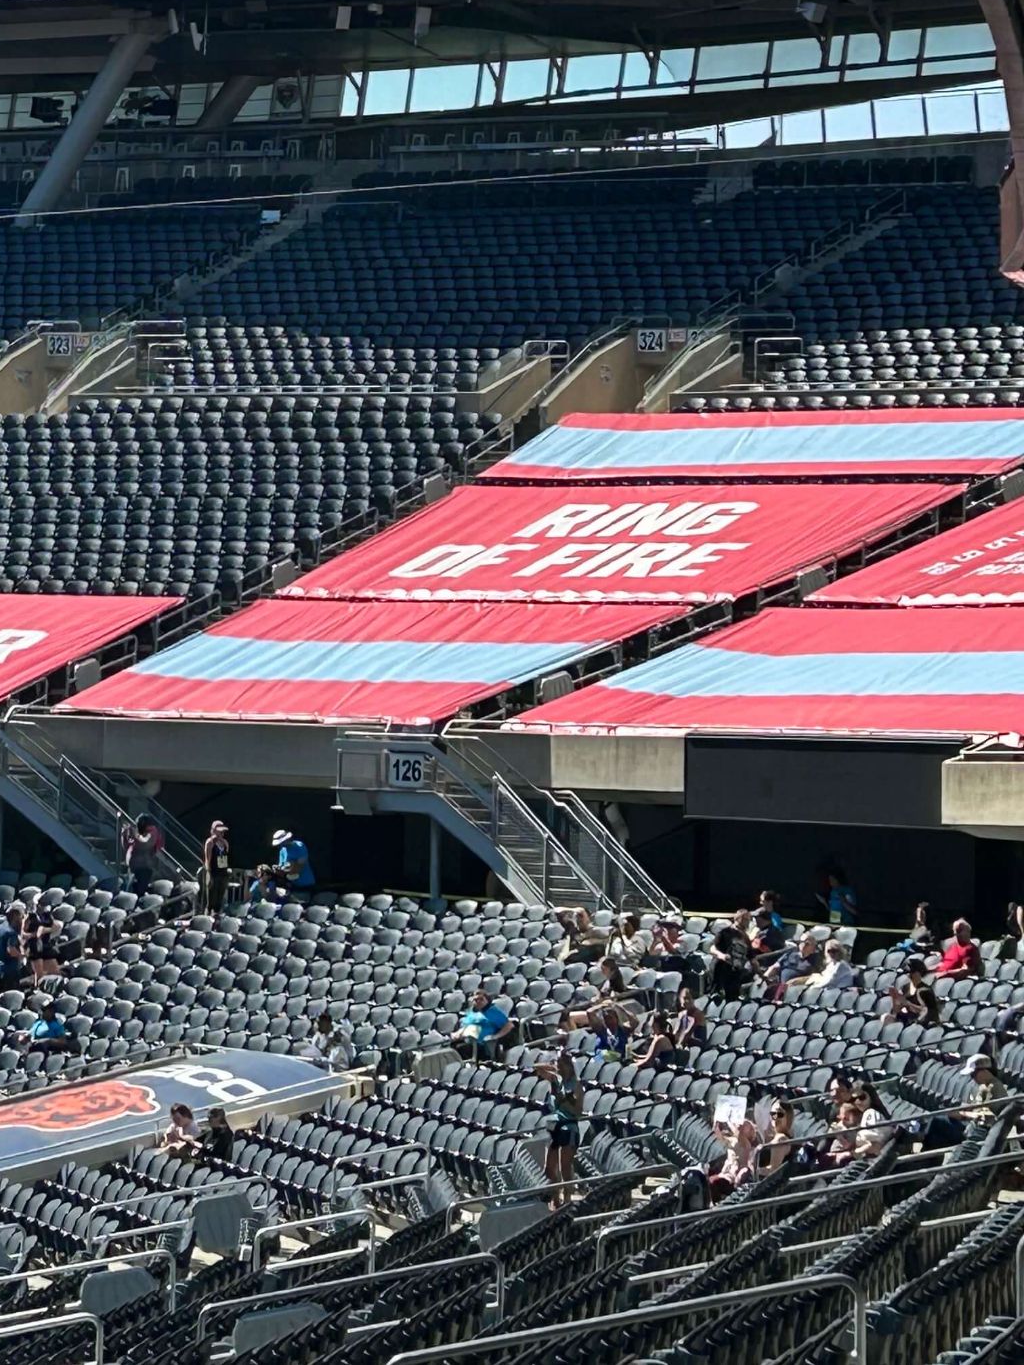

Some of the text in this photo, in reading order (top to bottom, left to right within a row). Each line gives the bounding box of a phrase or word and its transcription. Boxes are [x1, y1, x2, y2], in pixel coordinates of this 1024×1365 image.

[49, 337, 70, 355] 323
[639, 331, 663, 351] 324
[511, 501, 760, 538] RING
[388, 542, 753, 579] OF FIRE
[392, 758, 422, 782] 126
